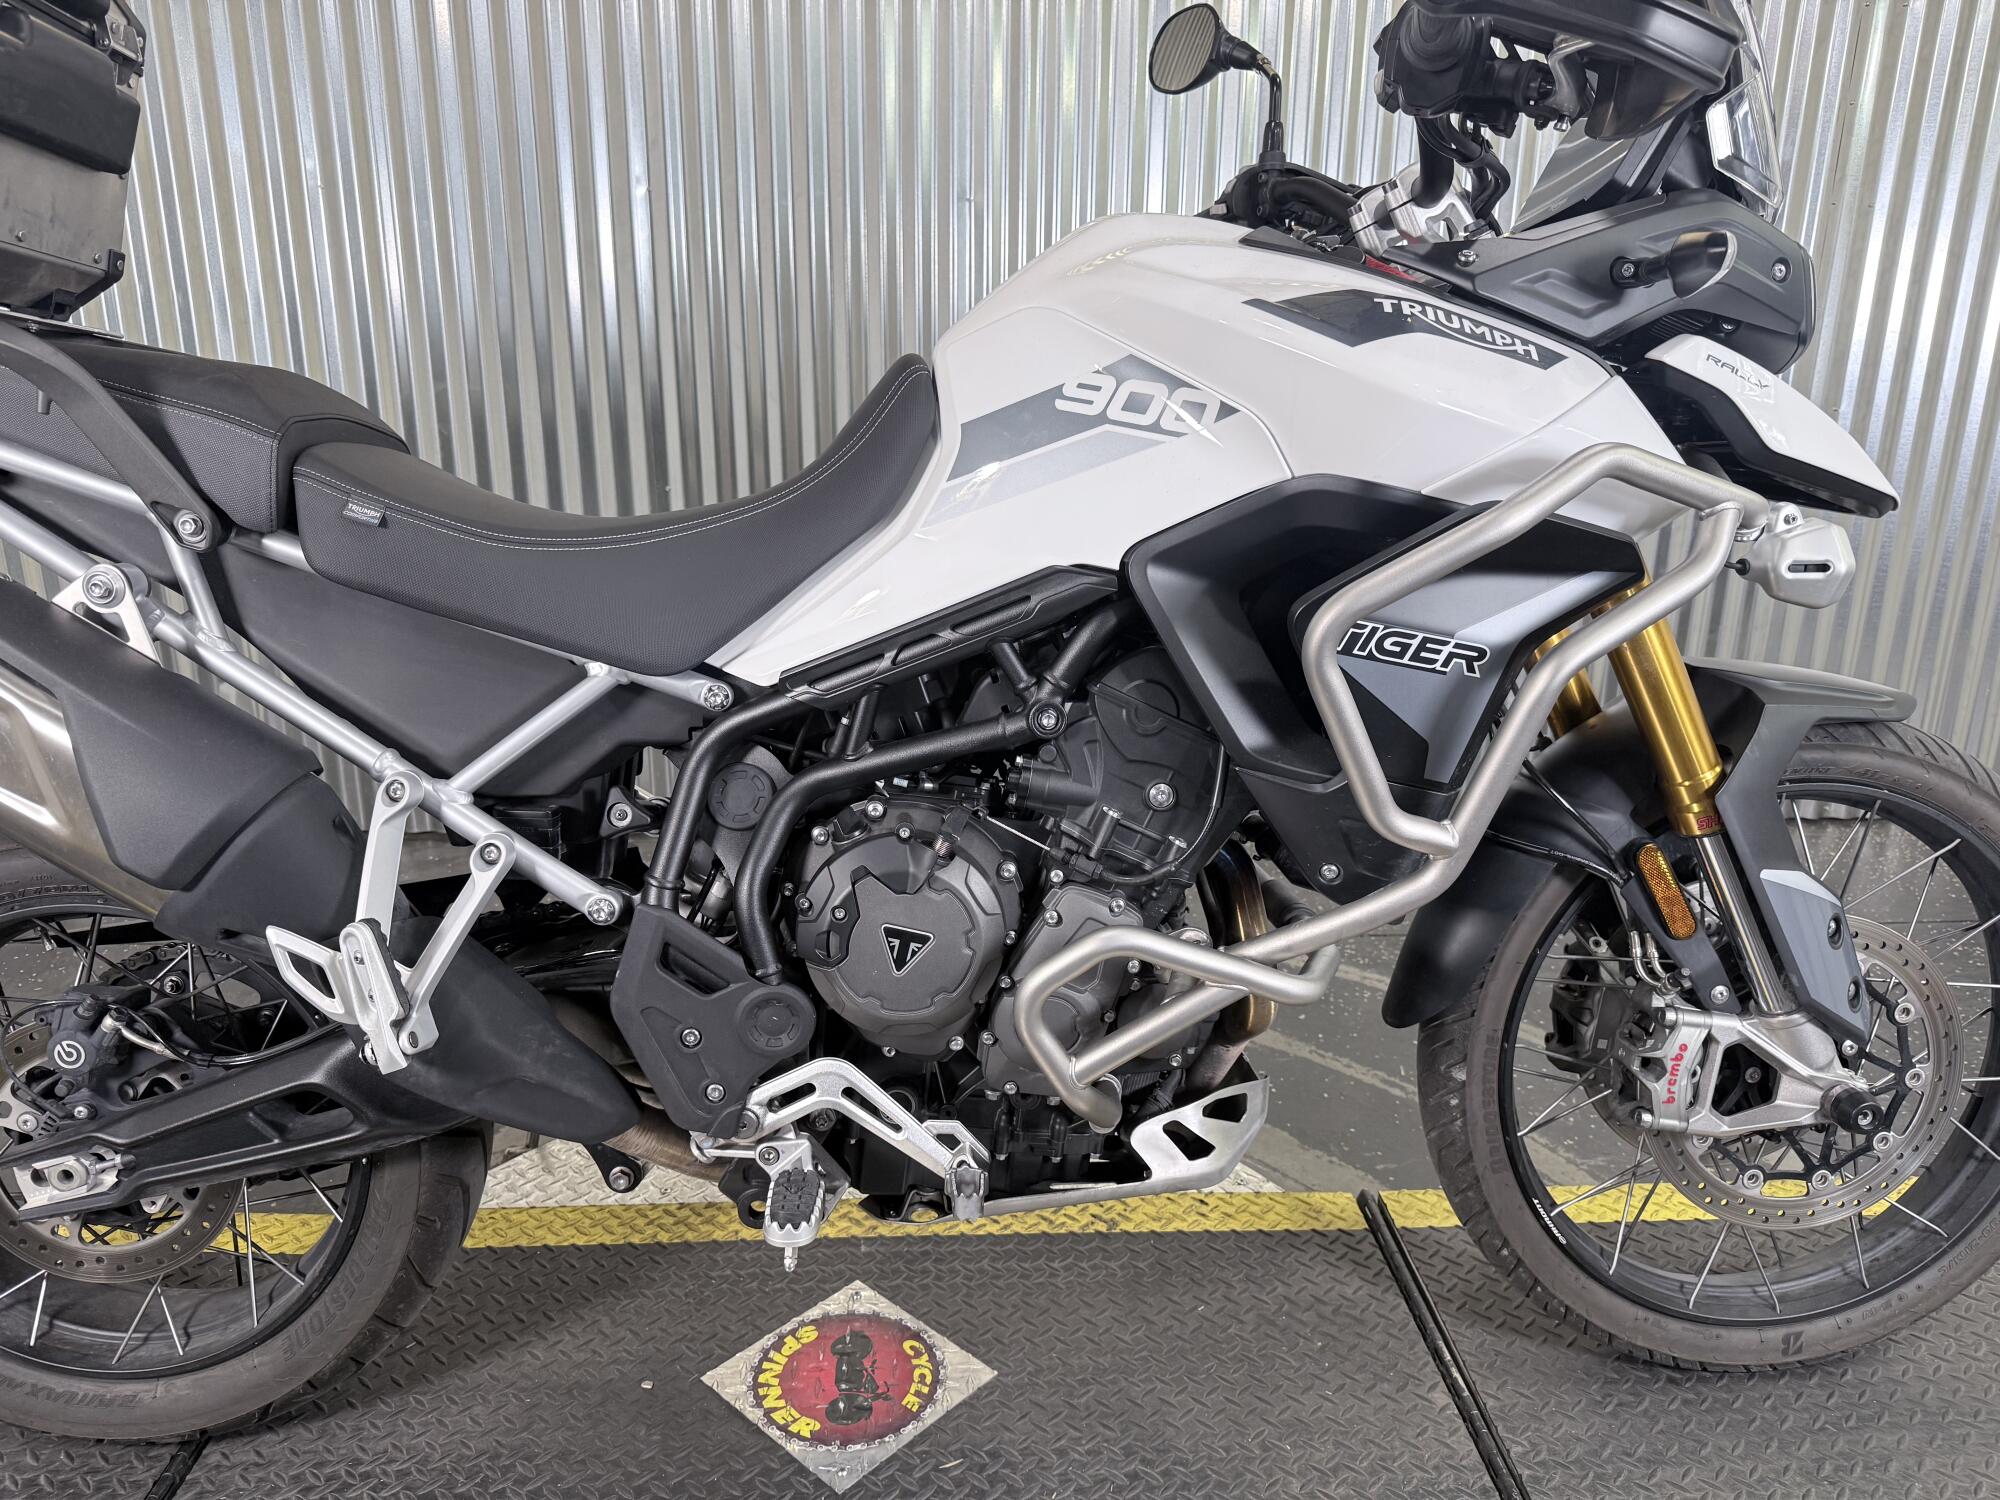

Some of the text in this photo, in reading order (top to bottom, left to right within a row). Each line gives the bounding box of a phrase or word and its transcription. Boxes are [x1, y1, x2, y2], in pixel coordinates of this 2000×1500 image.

[1373, 297, 1540, 362] TRIUMPH
[1706, 353, 1770, 390] RALLY
[1054, 372, 1222, 434] 900
[347, 502, 381, 518] TRIUMPH
[1336, 620, 1491, 679] TIGER
[1661, 1043, 1689, 1105] brembo
[757, 1325, 933, 1439] CYCLE SPINNER
